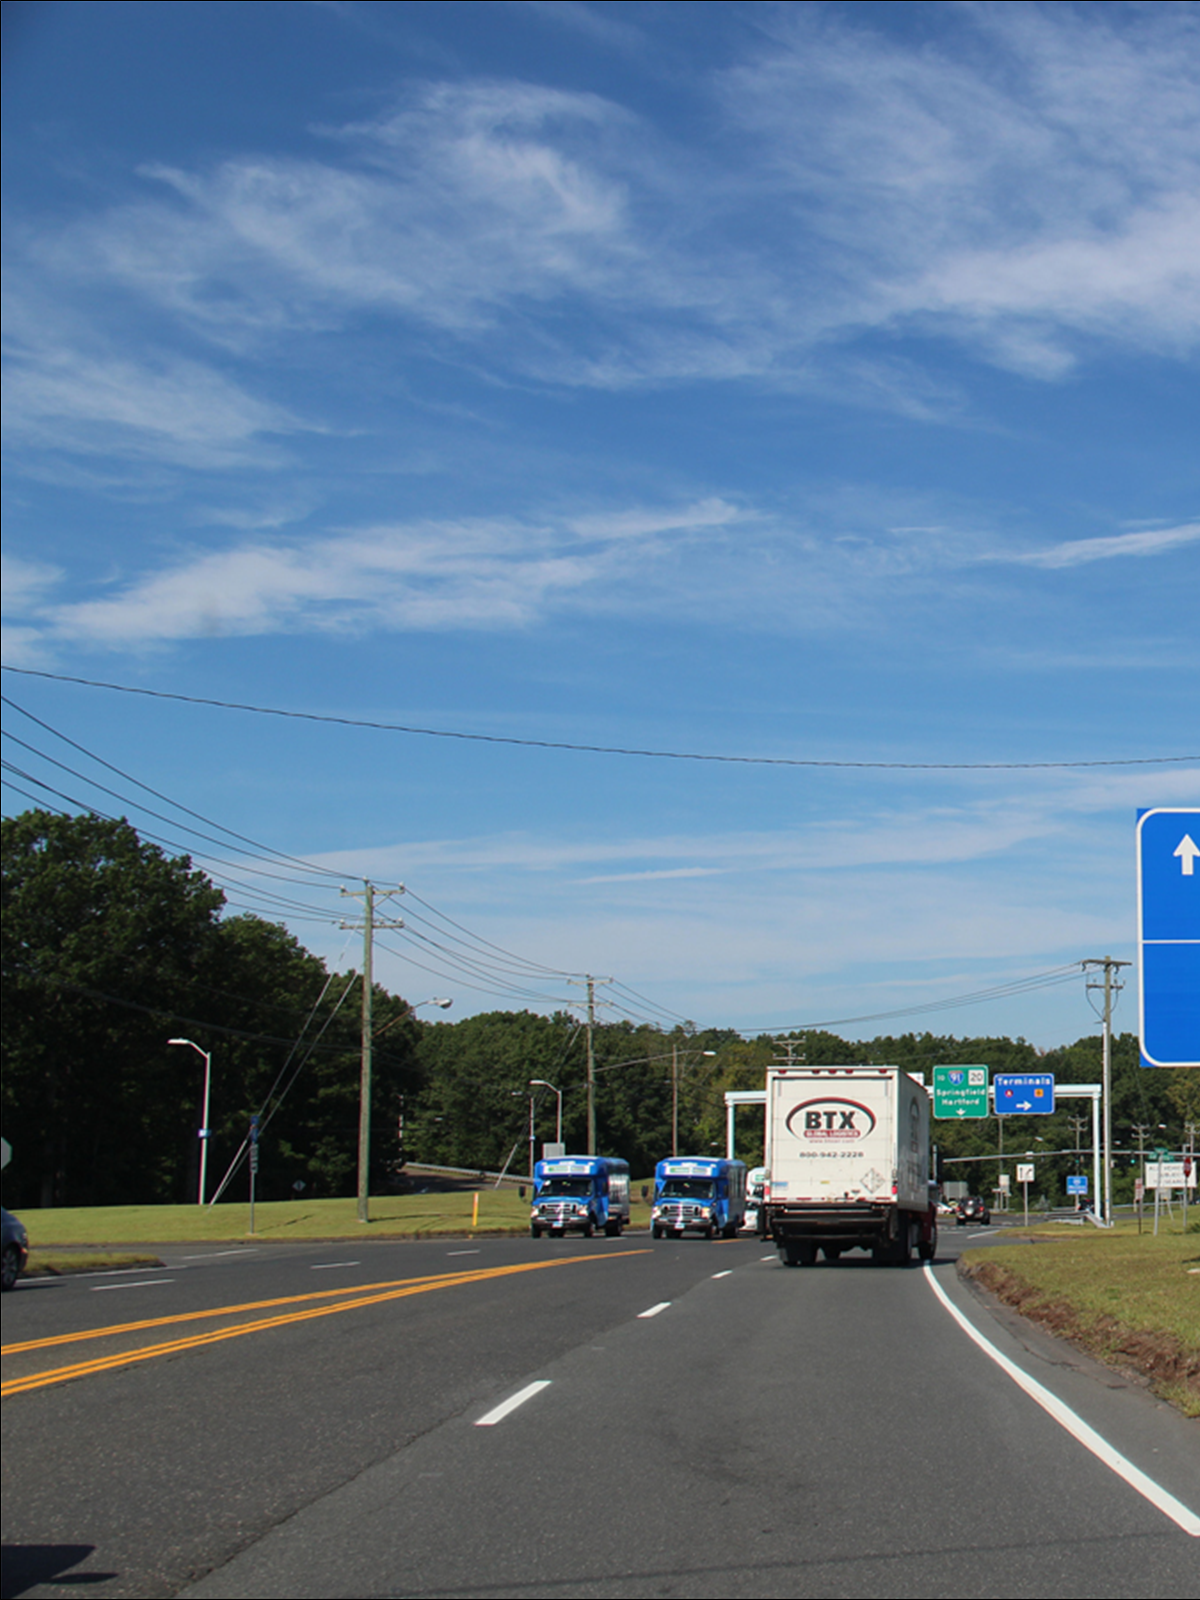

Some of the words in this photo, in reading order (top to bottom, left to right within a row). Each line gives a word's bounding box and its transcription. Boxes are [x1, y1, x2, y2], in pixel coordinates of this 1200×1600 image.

[951, 1074, 961, 1083] 91
[970, 1072, 983, 1082] 20
[997, 1078, 1051, 1086] Terminals
[936, 1089, 986, 1097] Springfield
[941, 1098, 980, 1106] Hartford
[806, 1111, 856, 1129] BTX
